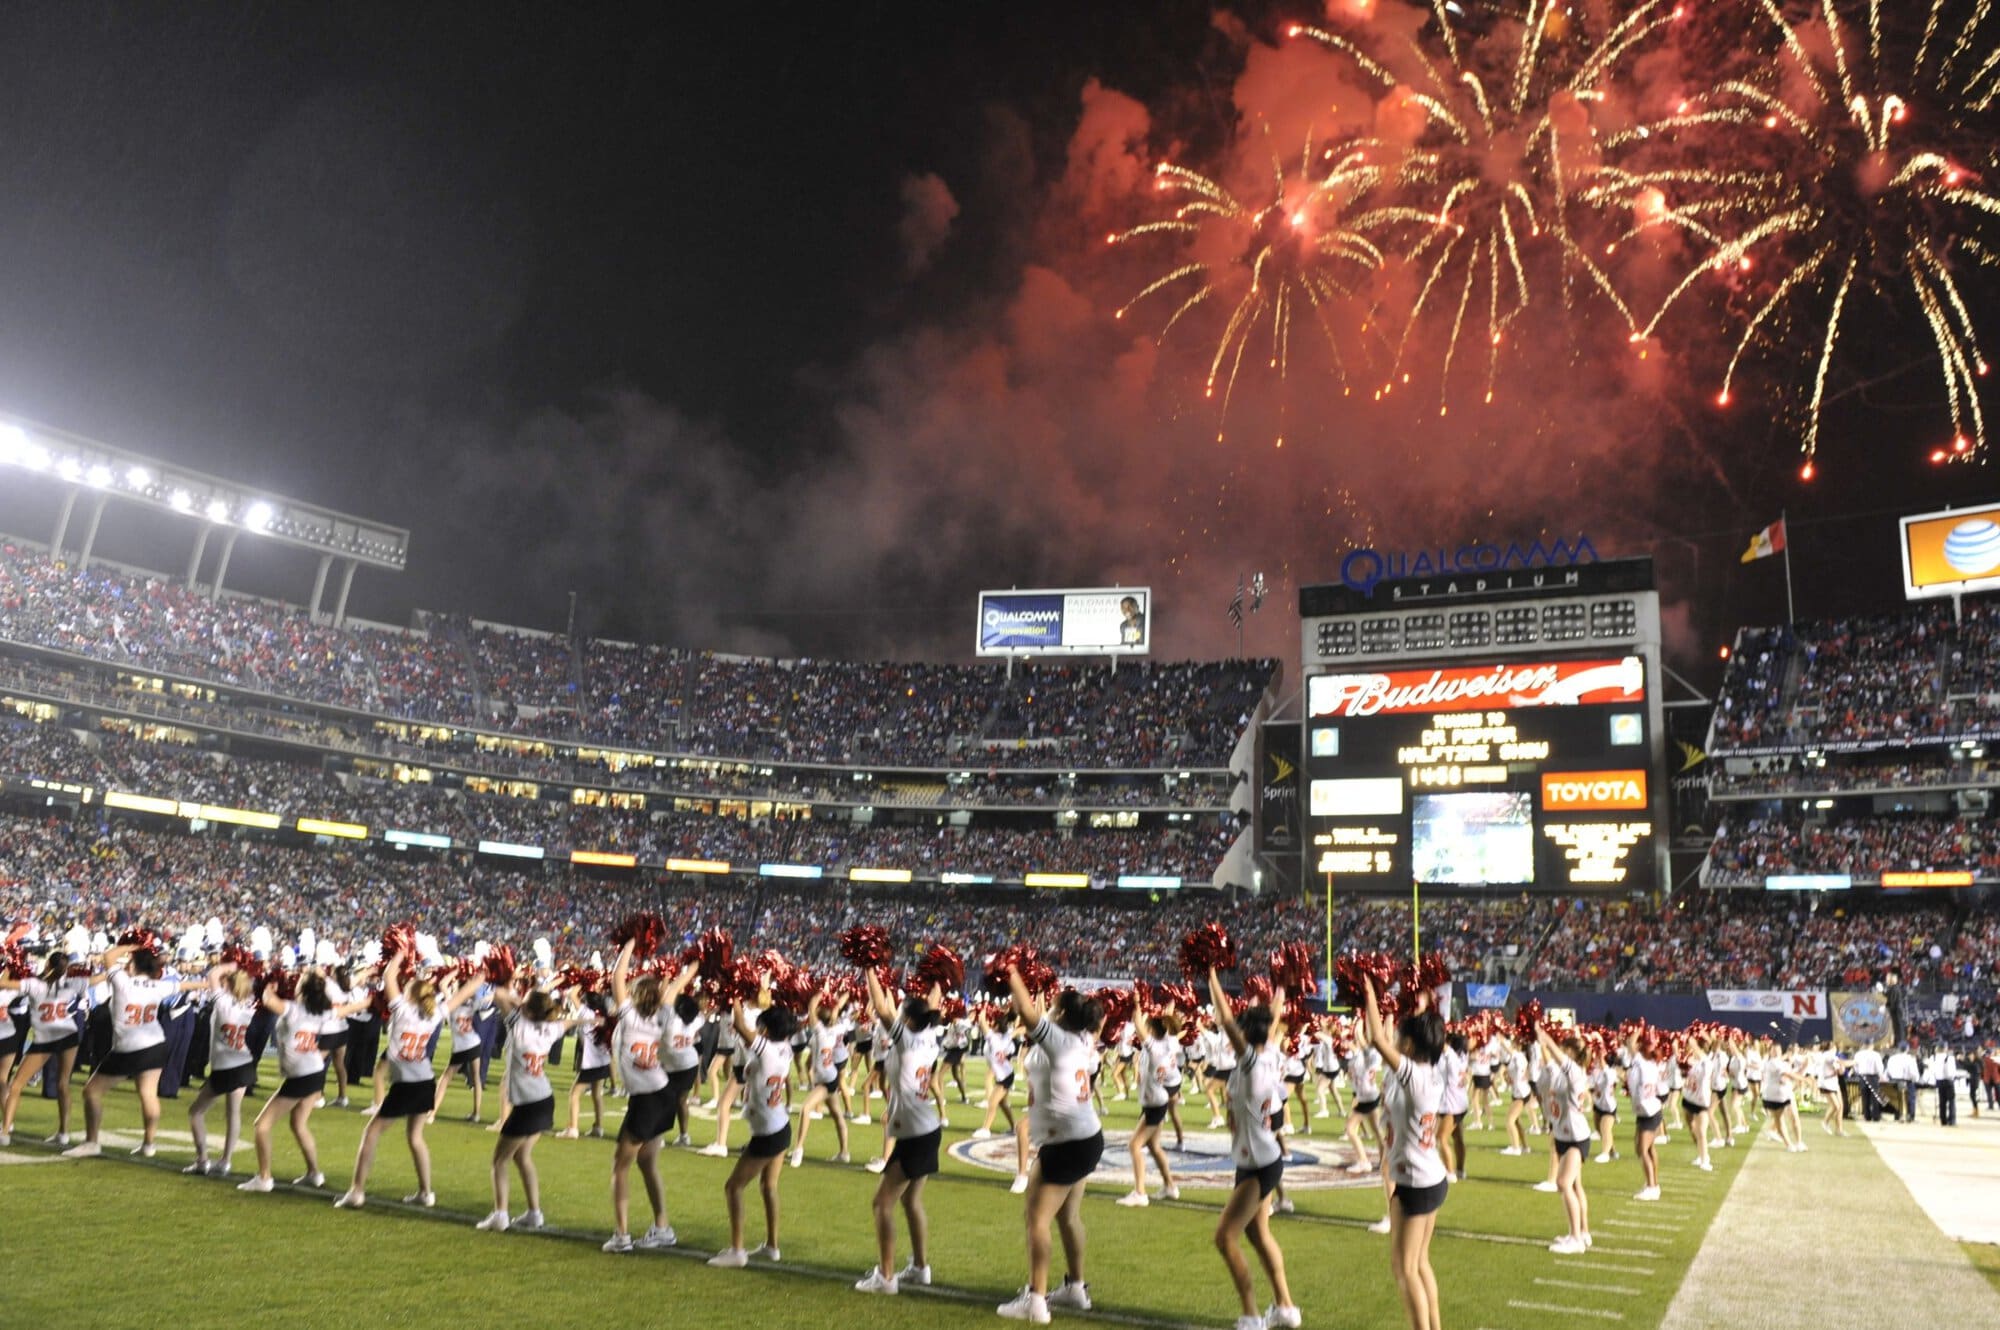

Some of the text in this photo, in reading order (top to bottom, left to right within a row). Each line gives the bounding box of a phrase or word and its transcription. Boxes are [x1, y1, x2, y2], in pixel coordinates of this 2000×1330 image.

[1341, 536, 1599, 599] QUALCOMM
[1393, 571, 1579, 598] STADIUM
[986, 609, 1060, 628] QUALCOMM
[1338, 665, 1558, 716] Budweiser
[1486, 711, 1506, 727] TO
[1451, 726, 1517, 745] PEPPER
[1264, 786, 1297, 800] Sprint
[1547, 780, 1642, 802] TOYOTA
[125, 1004, 157, 1025] 36
[1792, 995, 1817, 1015] N
[1075, 1068, 1090, 1103] 3
